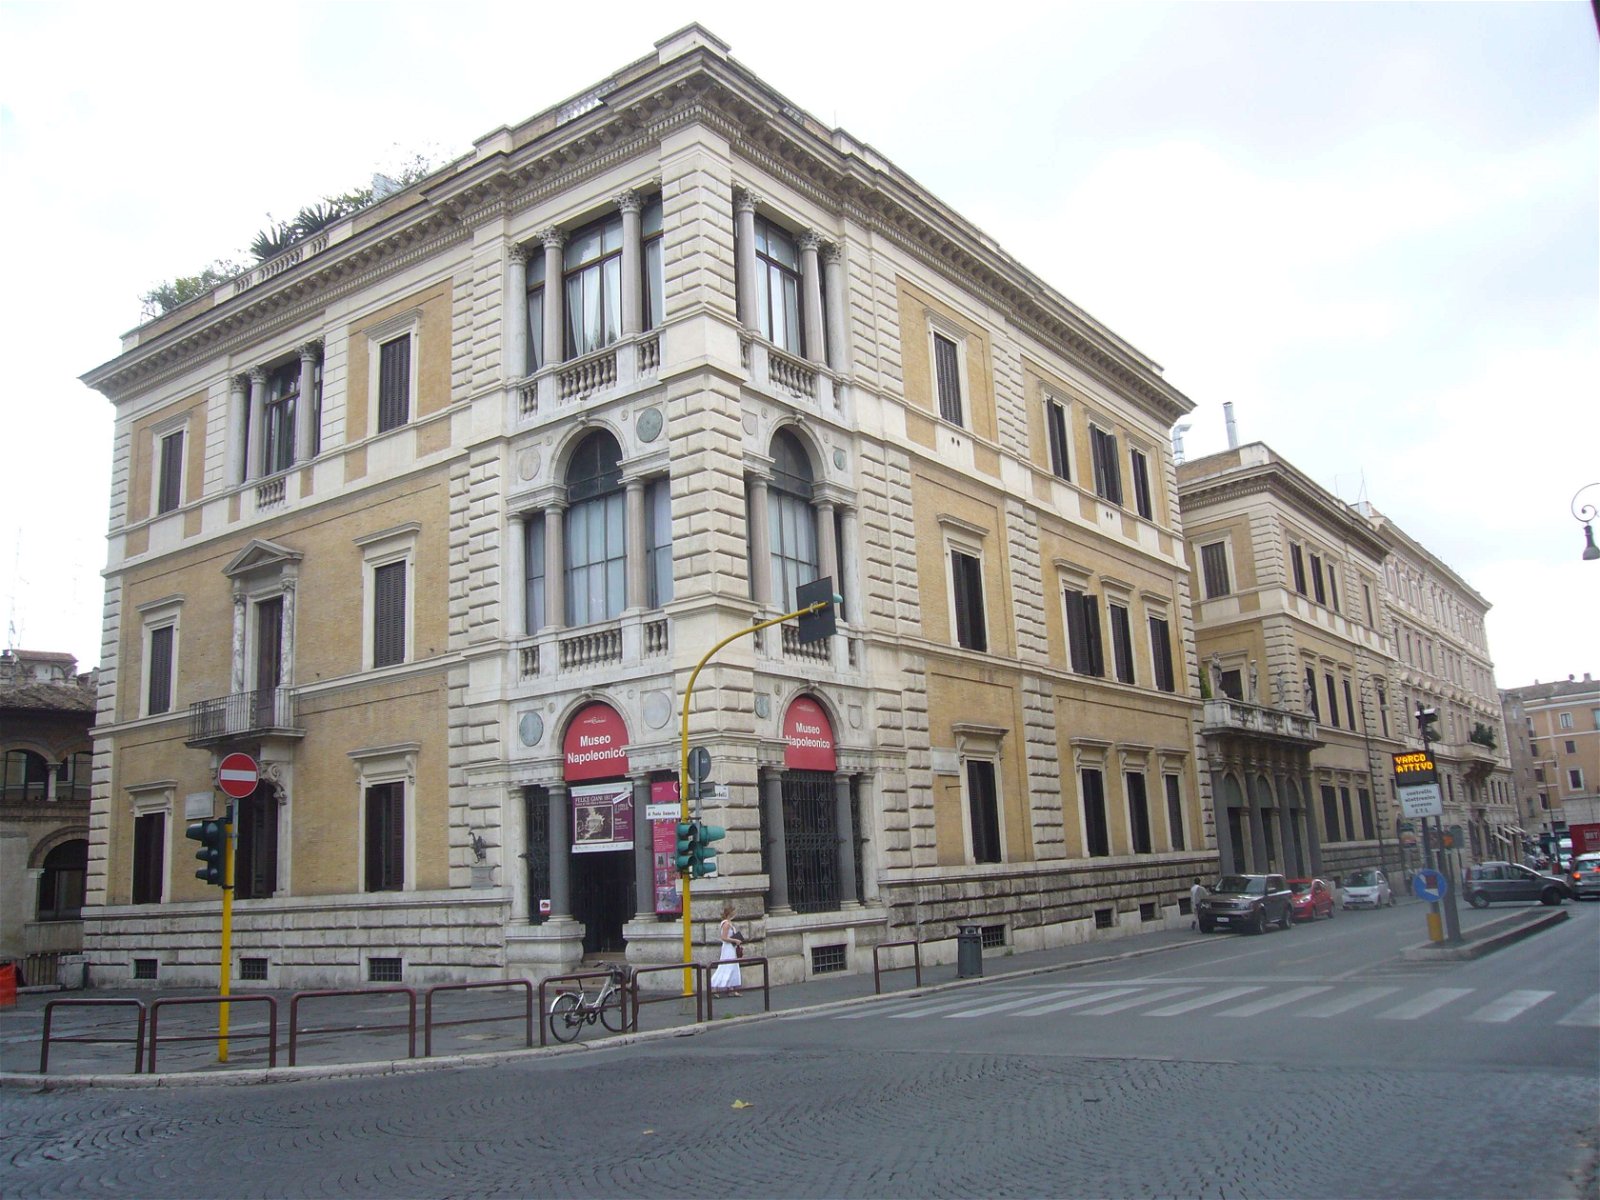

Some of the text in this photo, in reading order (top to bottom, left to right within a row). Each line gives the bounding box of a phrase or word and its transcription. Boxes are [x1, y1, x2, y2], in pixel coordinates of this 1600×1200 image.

[796, 722, 820, 734] Museo
[580, 735, 611, 747] Museo
[785, 735, 830, 748] Napoleonico
[567, 747, 625, 765] Napoleonico
[1394, 753, 1426, 764] VARCO
[1395, 761, 1434, 773] ATTIVO
